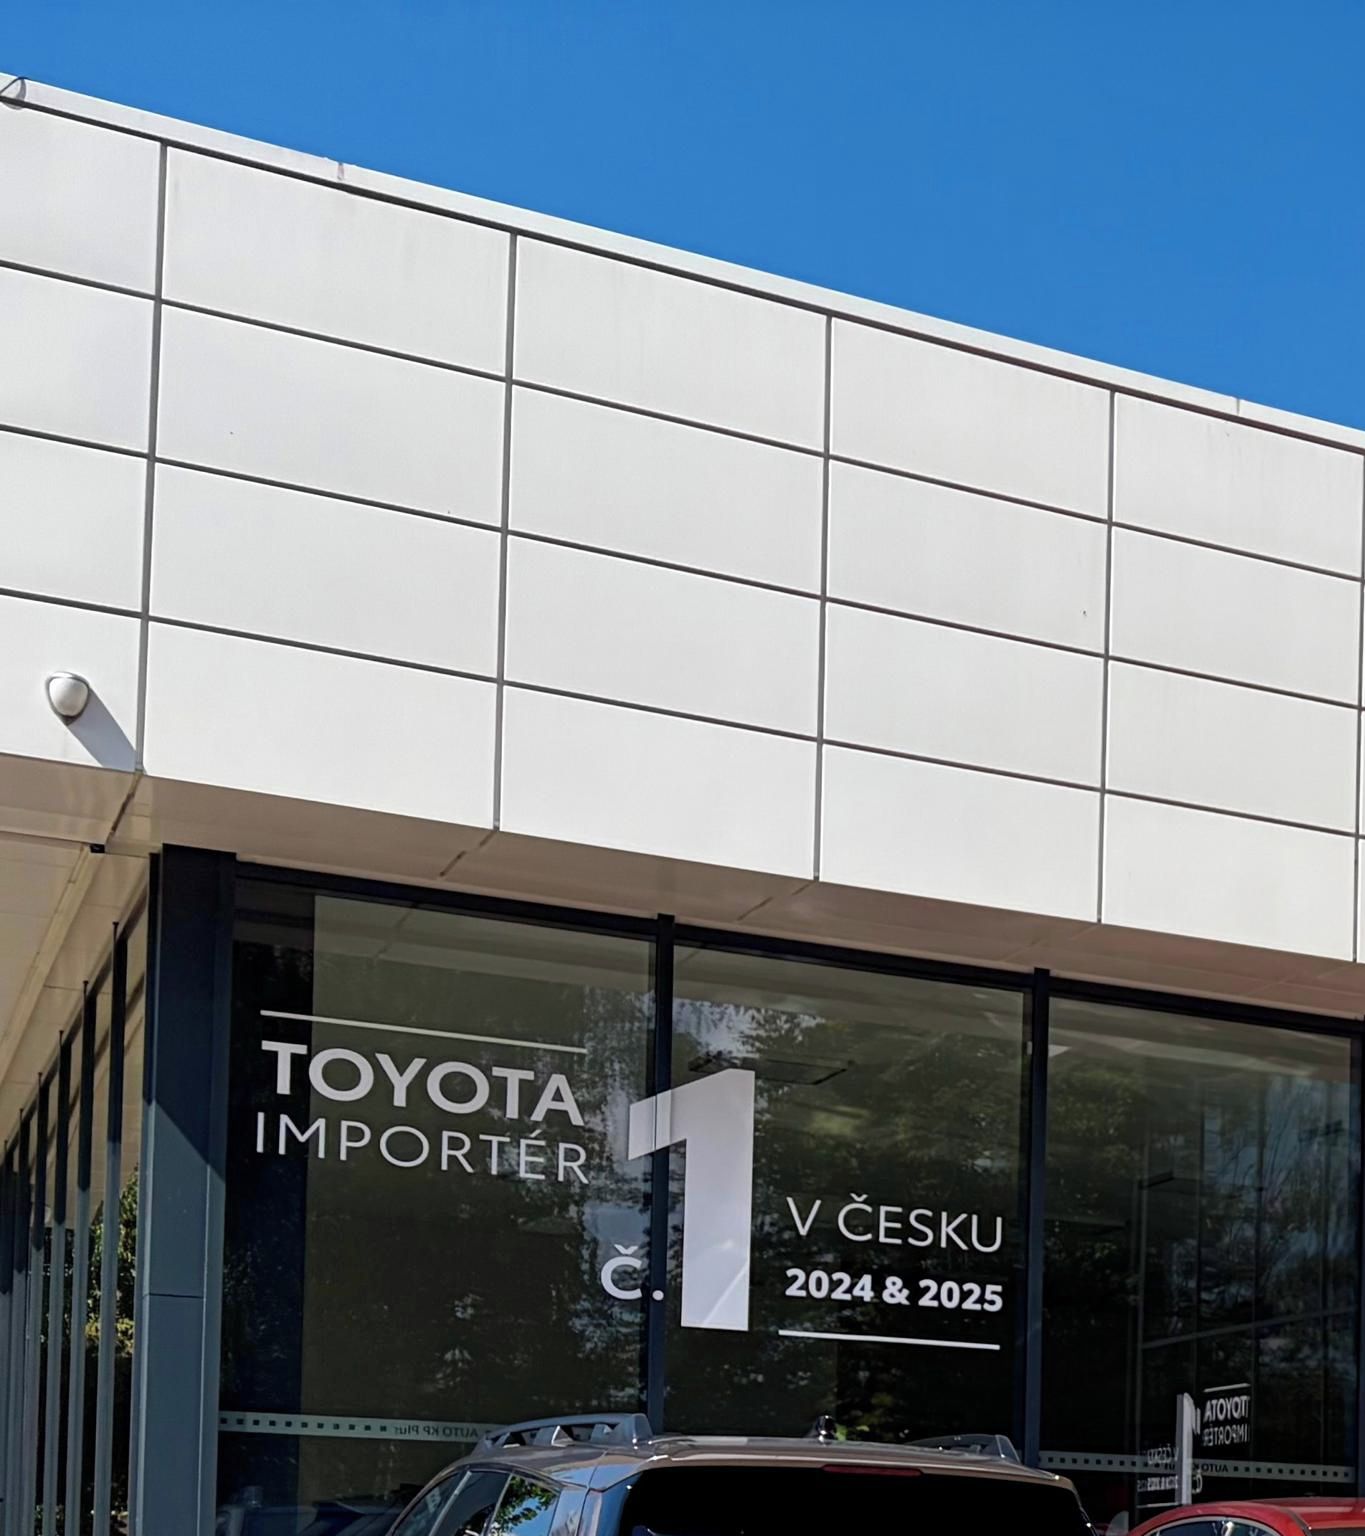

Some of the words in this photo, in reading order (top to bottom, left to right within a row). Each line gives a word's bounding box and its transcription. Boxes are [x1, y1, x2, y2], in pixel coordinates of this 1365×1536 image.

[261, 1040, 586, 1127] TOYOTA
[256, 1112, 590, 1184] IMPORTÉR
[628, 1068, 755, 1331] 1
[787, 1198, 821, 1236] V
[838, 1193, 1004, 1253] ČESKU
[600, 1243, 664, 1301] Č.
[785, 1268, 874, 1303] 2024
[882, 1276, 910, 1305] &
[918, 1279, 1004, 1312] 2025
